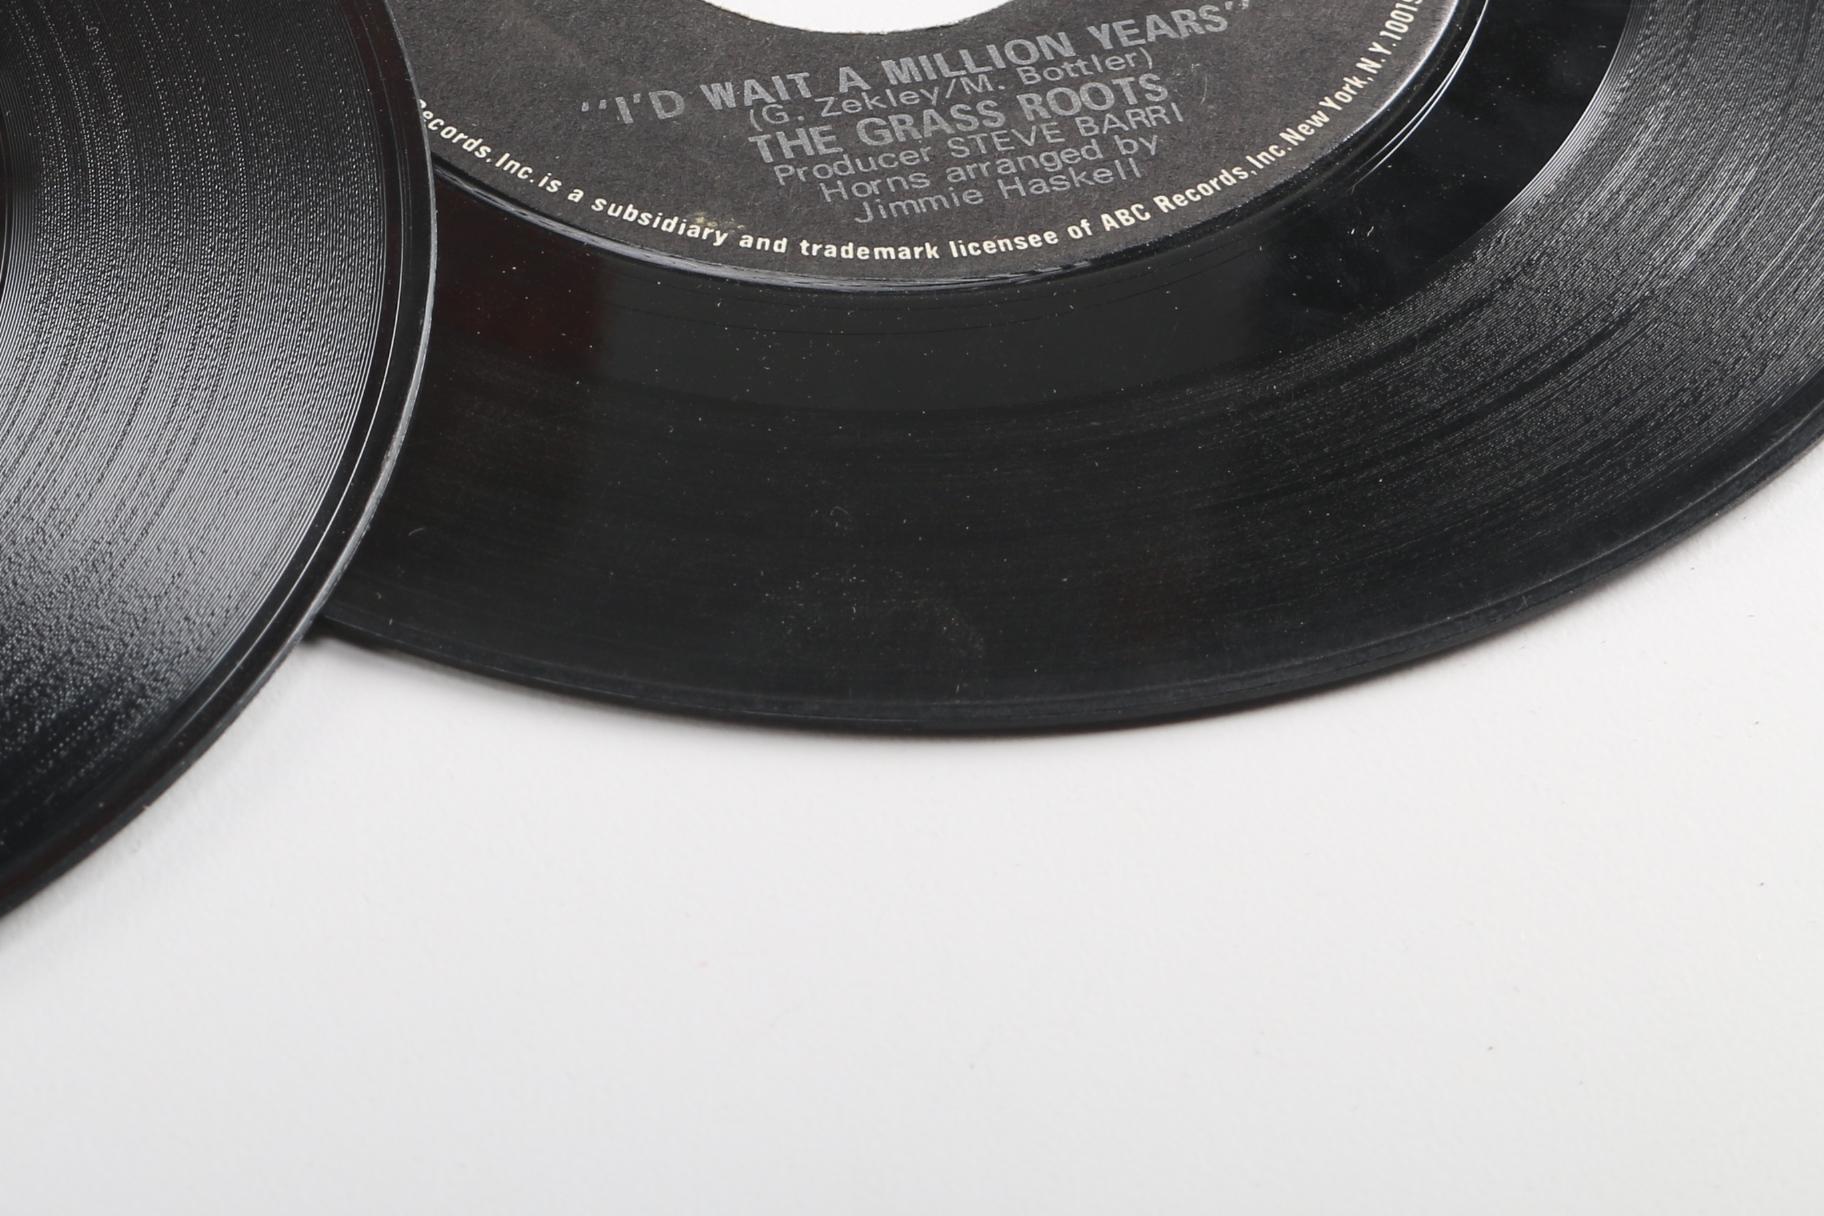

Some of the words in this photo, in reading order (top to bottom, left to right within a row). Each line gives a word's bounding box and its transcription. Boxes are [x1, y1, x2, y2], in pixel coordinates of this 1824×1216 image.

[699, 71, 812, 112] WAIT
[837, 65, 872, 94] A
[880, 31, 1077, 86] MILLION
[748, 103, 806, 132] (G.
[813, 74, 1006, 118] Zekley/M.
[1015, 46, 1154, 86] Bottler)
[747, 125, 845, 164] THE
[856, 99, 1007, 147] GRASS
[1015, 72, 1170, 122] ROOTS
[773, 143, 933, 187] Producer
[945, 120, 1067, 160] STEVE
[1074, 102, 1186, 137] BARRI
[494, 152, 535, 184] Inc.
[537, 171, 564, 194] is
[567, 186, 585, 204] a
[590, 195, 730, 247] subsidiary
[738, 229, 788, 255] and
[799, 238, 941, 261] trademark
[948, 228, 1060, 259] licensee
[1066, 218, 1095, 241] of
[1100, 202, 1153, 234] ABC
[1278, 109, 1331, 148] New
[818, 171, 932, 204] Horns
[944, 138, 1105, 185] arranged
[1114, 133, 1160, 157] by
[853, 186, 986, 224] Jimmie
[996, 157, 1143, 200] Haskell
